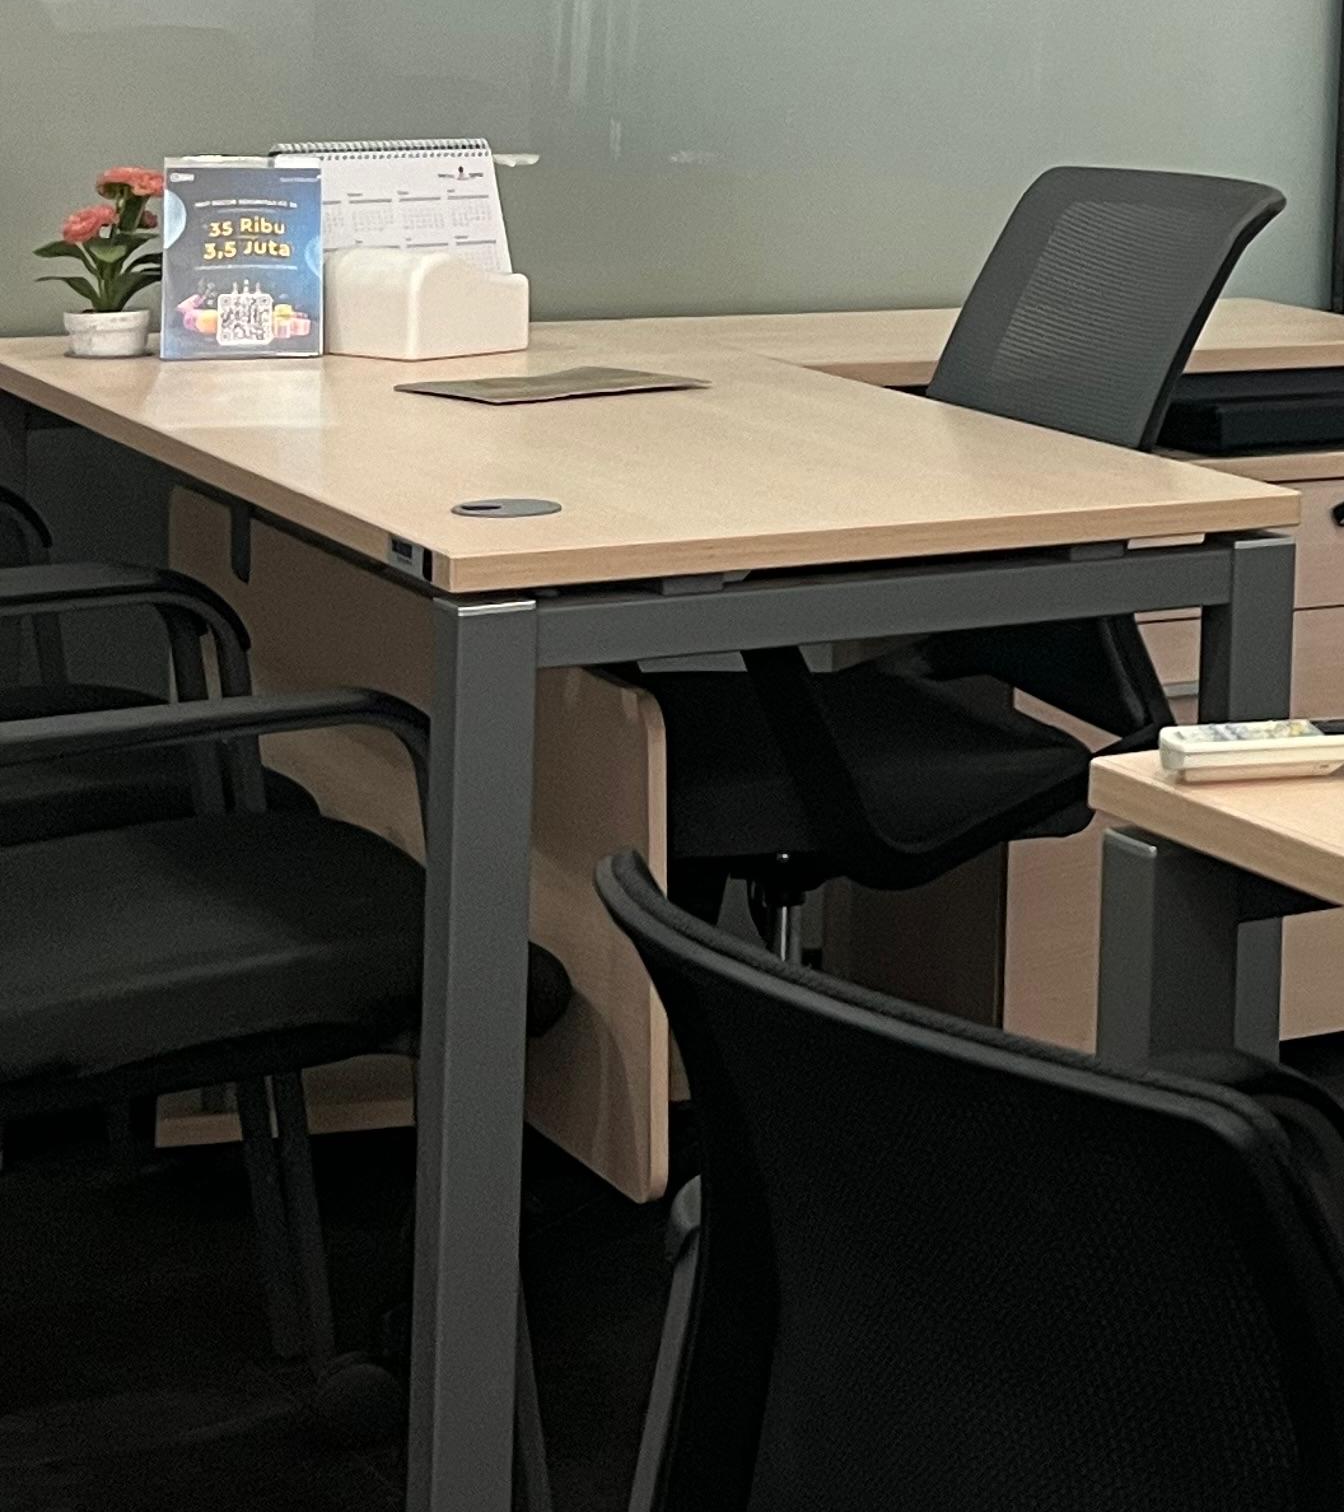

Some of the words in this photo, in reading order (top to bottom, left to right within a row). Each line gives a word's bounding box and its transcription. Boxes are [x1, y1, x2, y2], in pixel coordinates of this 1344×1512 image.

[208, 220, 234, 238] 35
[239, 215, 286, 235] Ribu
[203, 240, 237, 261] 3,5
[242, 239, 292, 258] Juta
